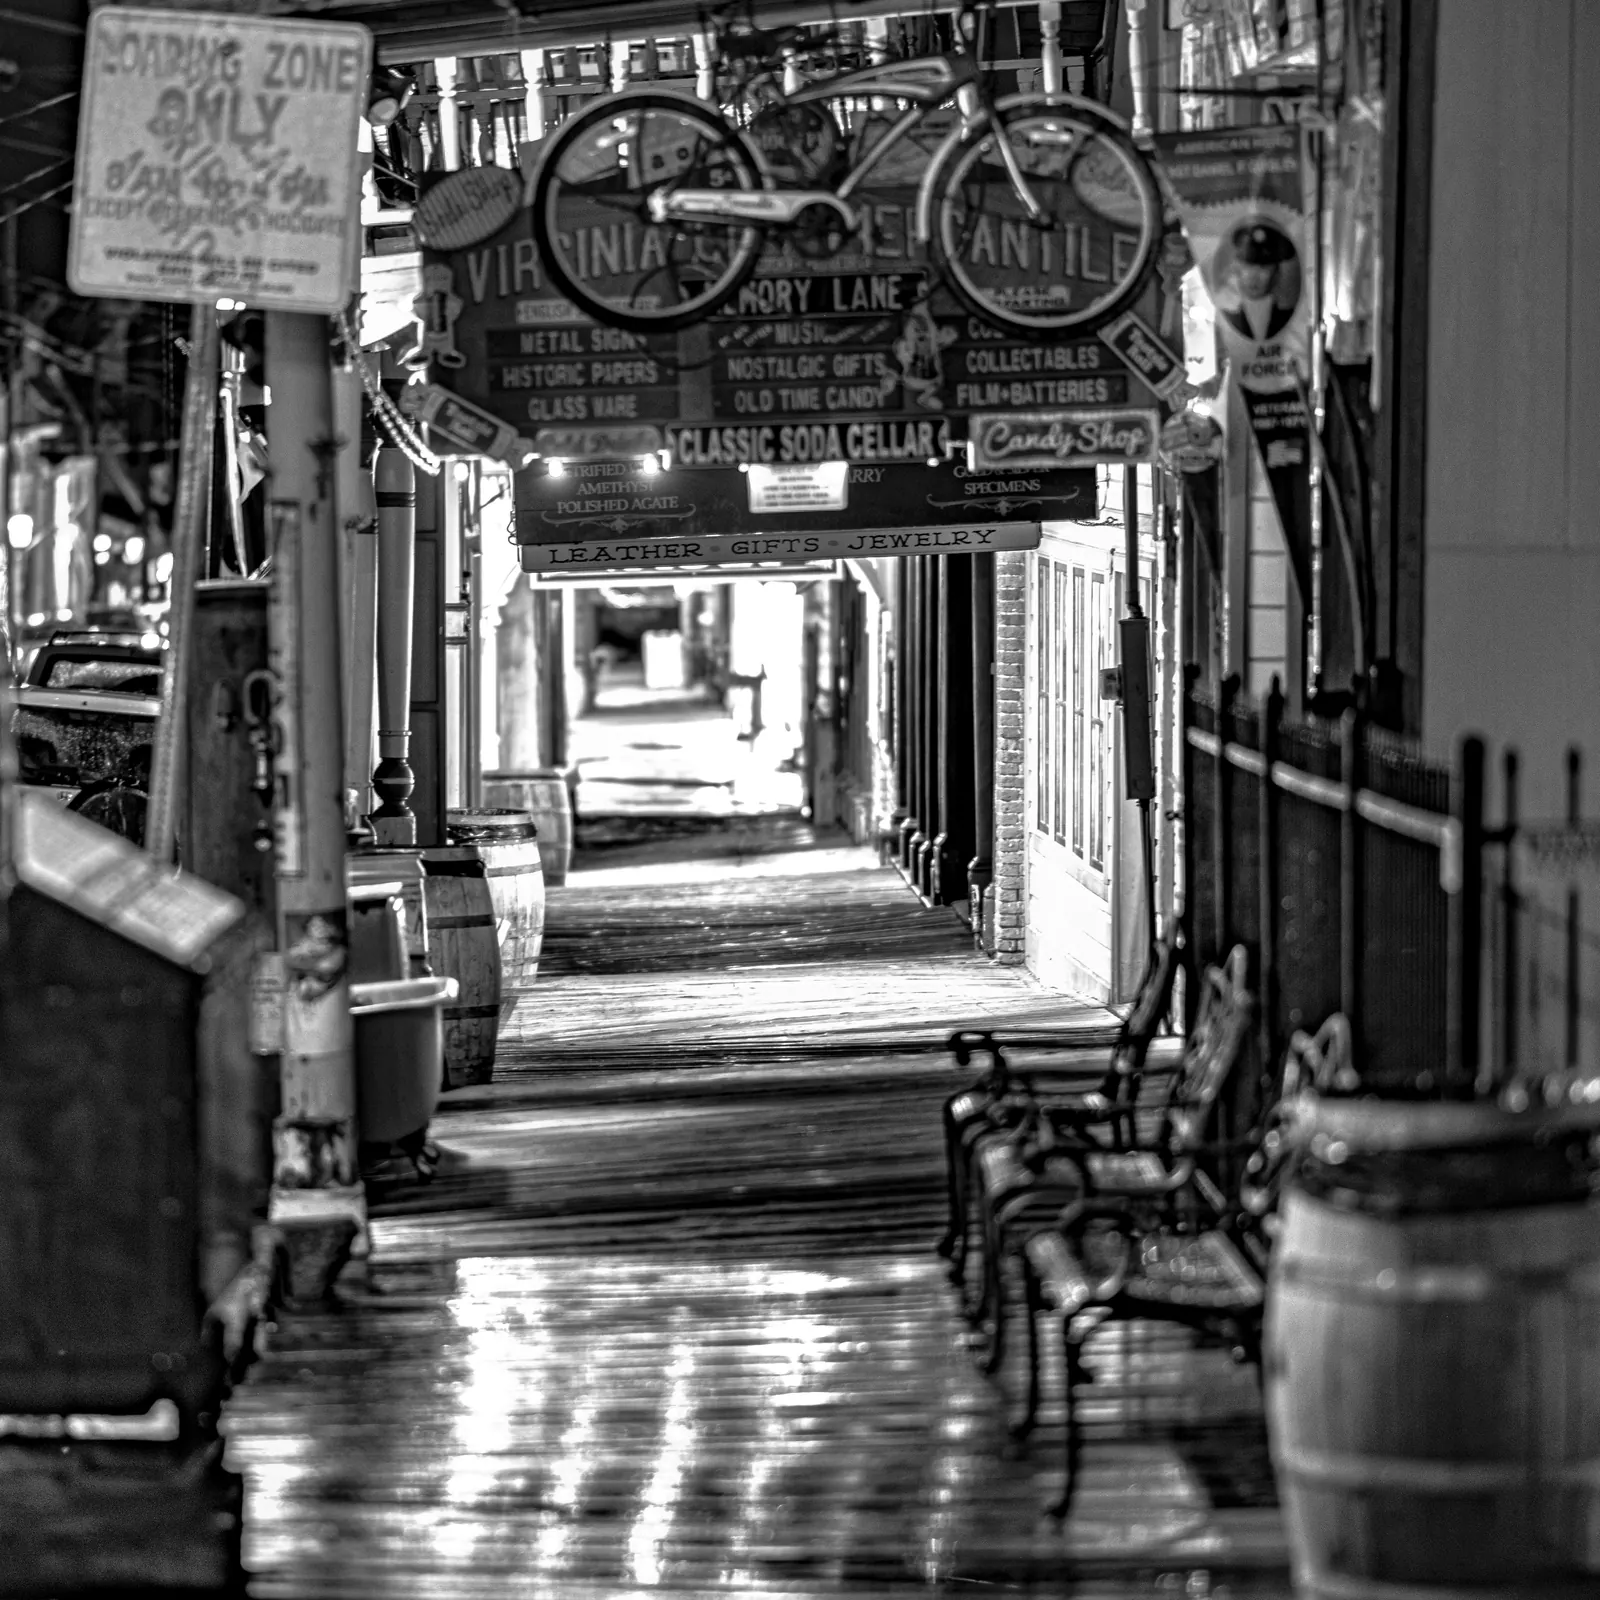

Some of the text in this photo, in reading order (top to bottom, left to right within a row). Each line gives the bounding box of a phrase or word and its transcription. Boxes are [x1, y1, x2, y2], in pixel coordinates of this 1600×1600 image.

[263, 43, 357, 92] ZONE
[154, 86, 288, 145] ONLY
[832, 275, 903, 312] LANE
[520, 330, 584, 354] METAL
[1256, 345, 1281, 358] AIR
[728, 352, 889, 381] NOSTALGIC GIFTS
[965, 345, 1101, 373] COLLECTABLES
[502, 360, 659, 389] HISTORIC PAPERS
[528, 394, 638, 421] GLASS WARE
[735, 385, 886, 413] OLD TIME CANDY
[957, 382, 1000, 407] FILM
[678, 427, 775, 464] CLASSIC
[779, 424, 842, 461] SODA
[847, 421, 935, 459] CELLAR
[984, 419, 1145, 458] Candy Shop
[576, 480, 653, 496] AMETHYST
[964, 479, 1041, 495] SPECIMENS
[556, 496, 679, 514] POLISHED AGATE
[550, 529, 997, 565] LEATHER GIFTS JEWELRY
